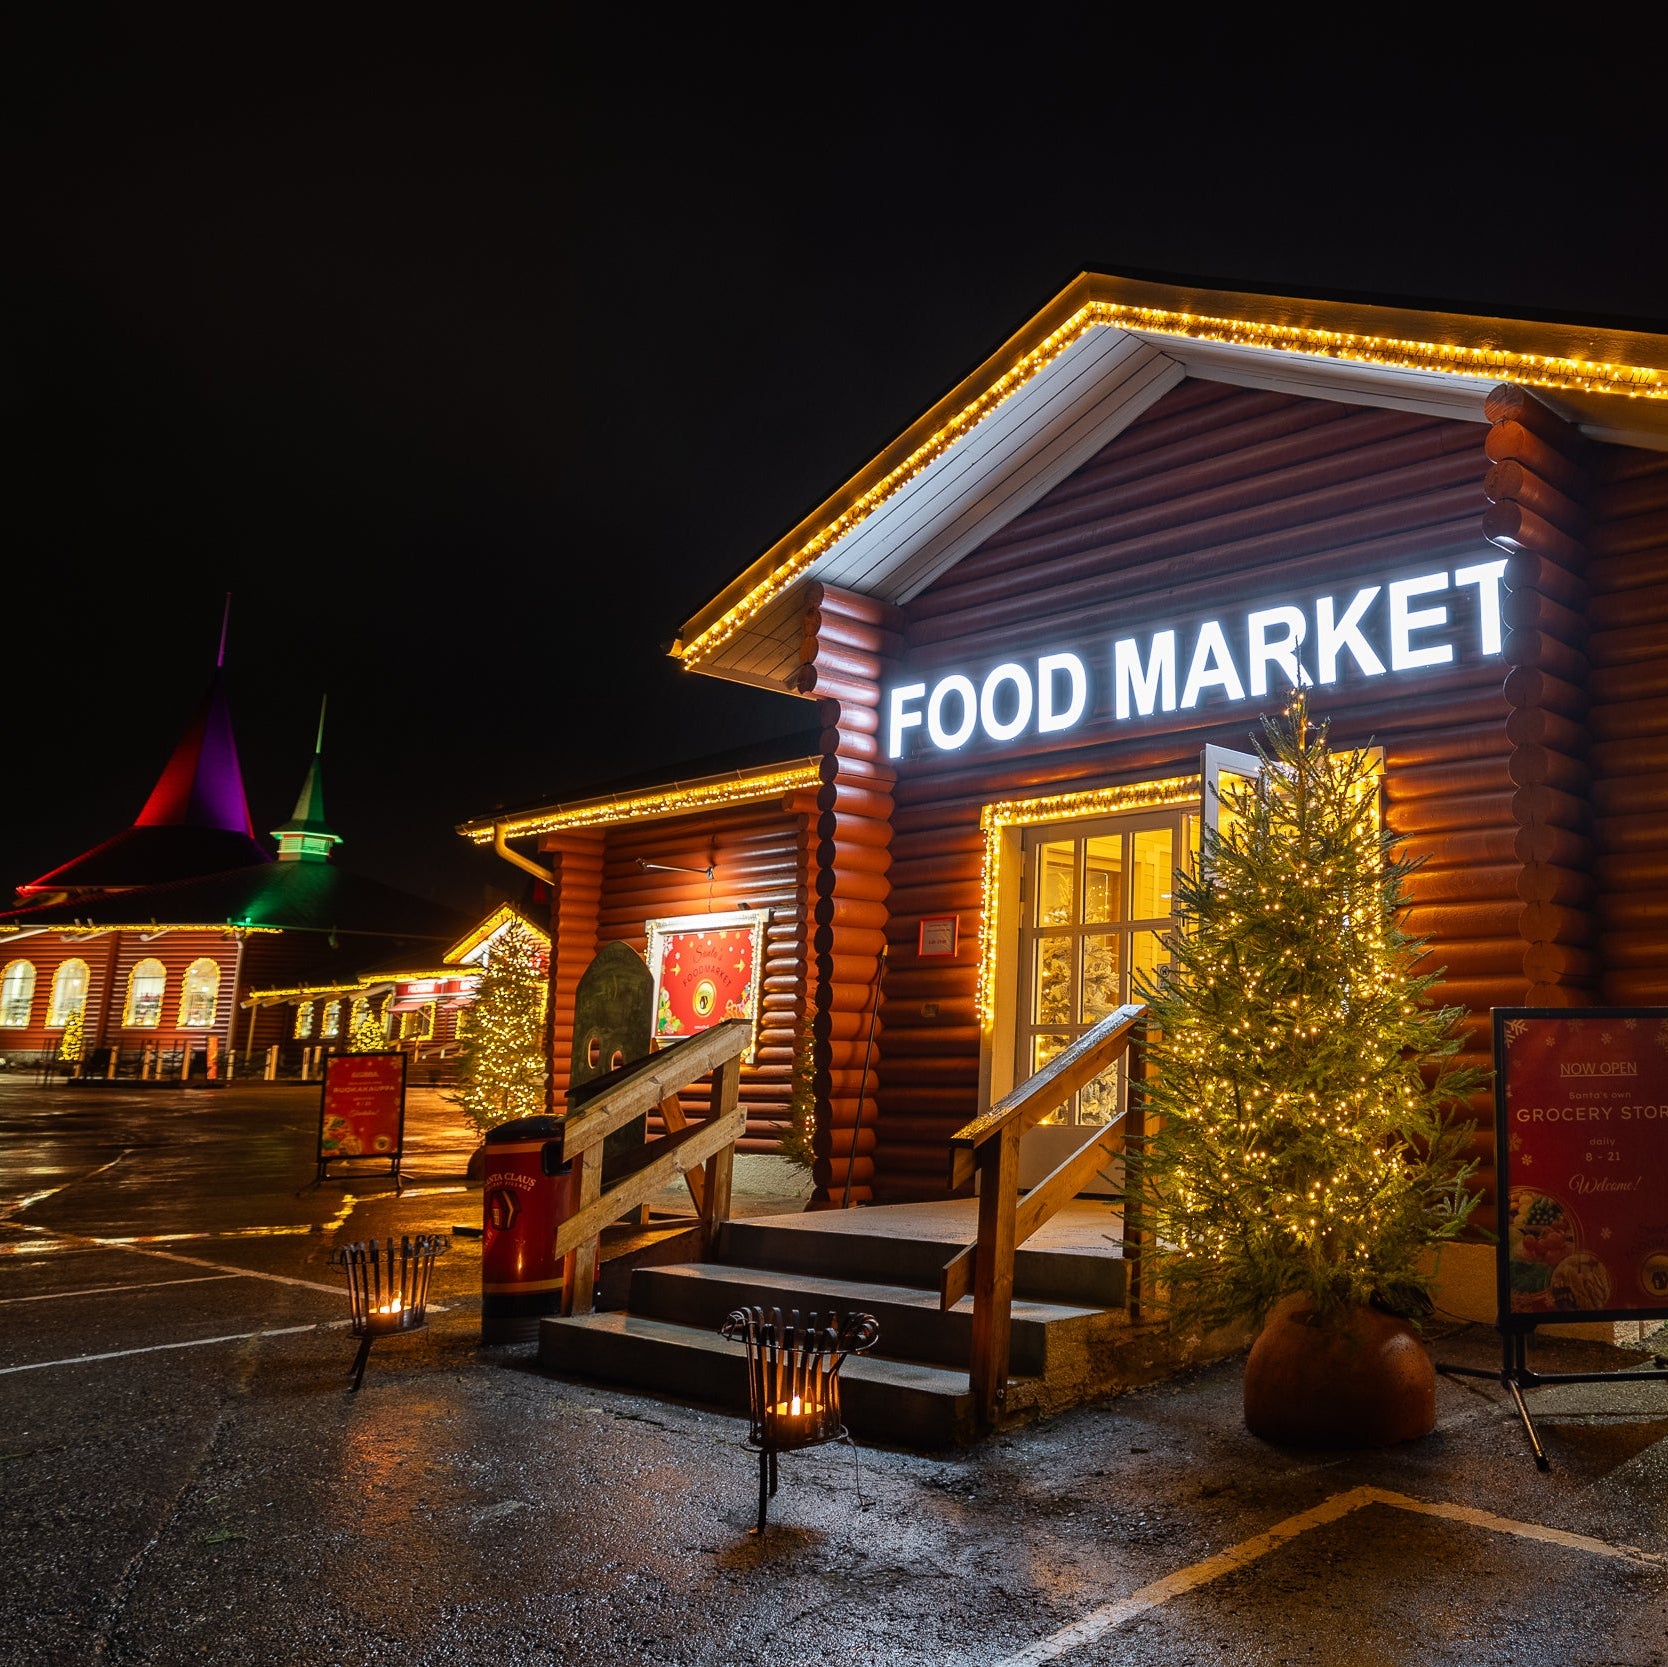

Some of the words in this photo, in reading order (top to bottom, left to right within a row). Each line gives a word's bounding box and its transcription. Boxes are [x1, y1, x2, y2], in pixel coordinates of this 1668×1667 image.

[889, 652, 1088, 759] FOOD
[1115, 558, 1509, 719] MARKET
[1560, 1063, 1596, 1075] NOW
[1600, 1062, 1637, 1074] OPEN
[1568, 1091, 1609, 1100] Santa's
[1611, 1091, 1631, 1099] own
[1517, 1106, 1613, 1122] GROCERY
[1589, 1137, 1616, 1146] daily
[1585, 1152, 1593, 1162] 8
[1607, 1151, 1621, 1161] 21
[504, 1172, 537, 1187] CLAUS
[1568, 1173, 1642, 1195] Welcome!
